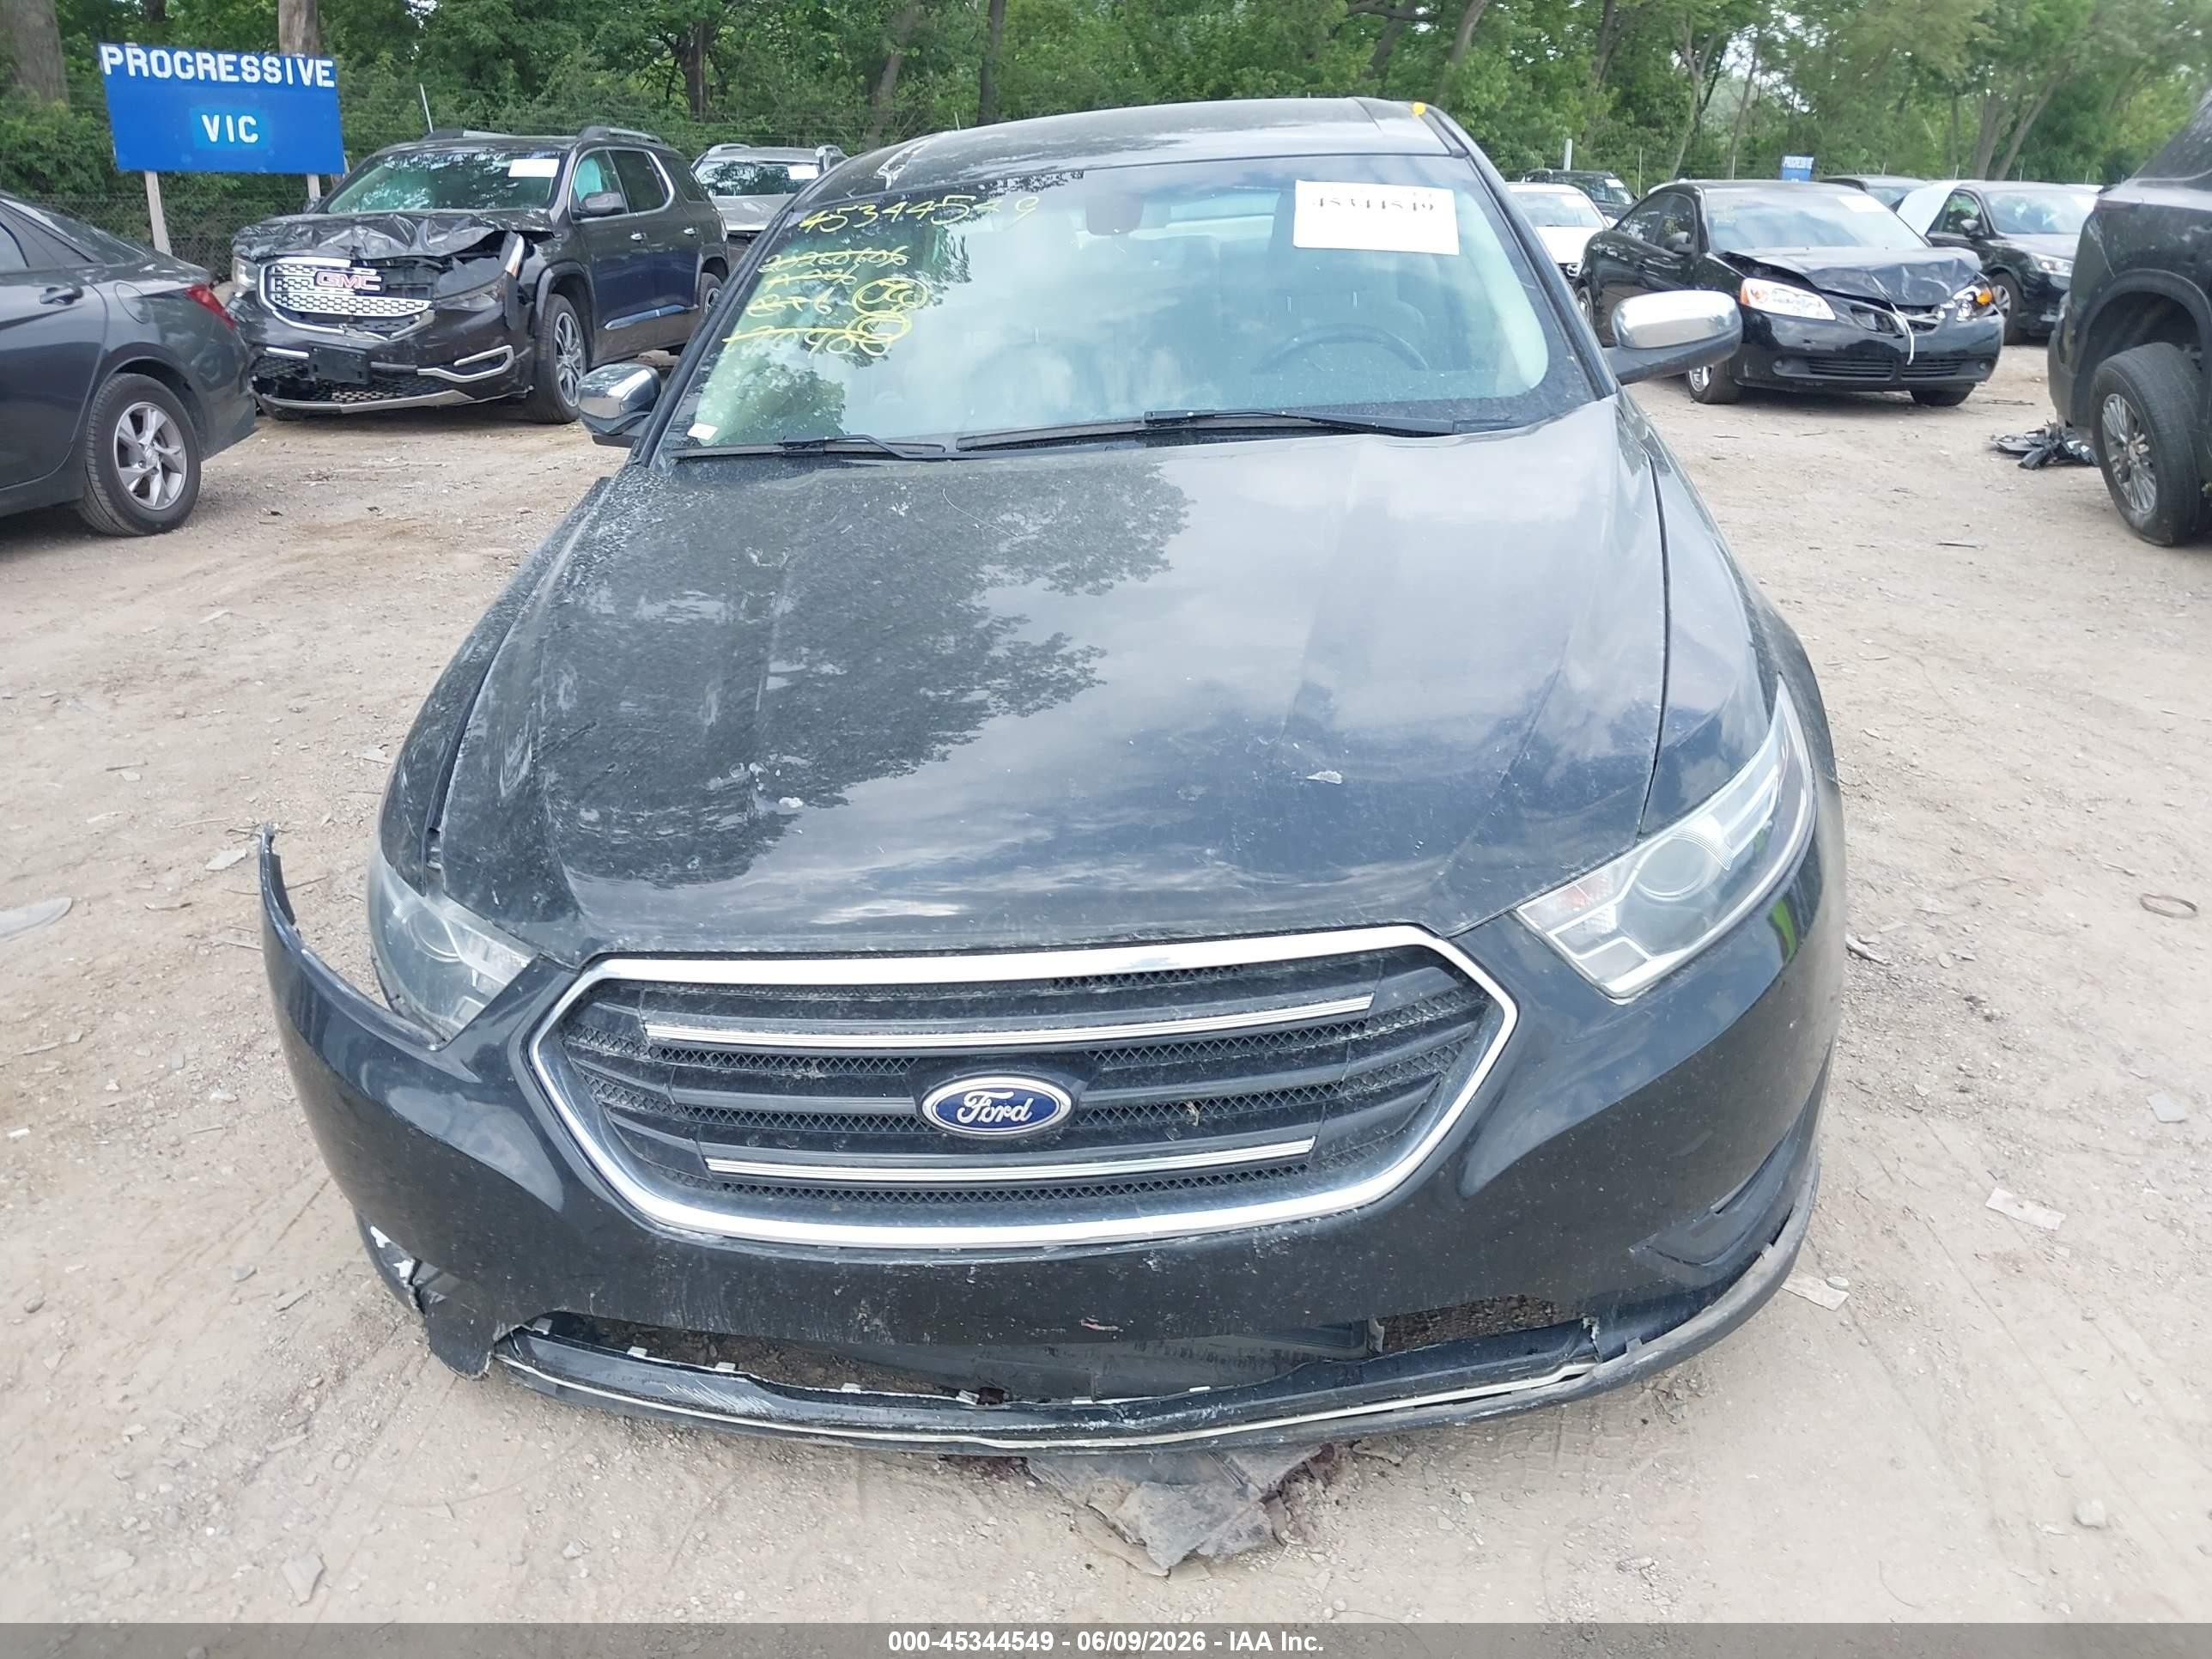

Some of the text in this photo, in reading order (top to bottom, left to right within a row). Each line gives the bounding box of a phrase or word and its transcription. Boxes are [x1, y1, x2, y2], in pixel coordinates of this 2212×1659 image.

[100, 46, 335, 88] PROGRESSIVE
[201, 114, 258, 143] VIC
[316, 270, 382, 291] GMC
[956, 1091, 1034, 1124] Ford
